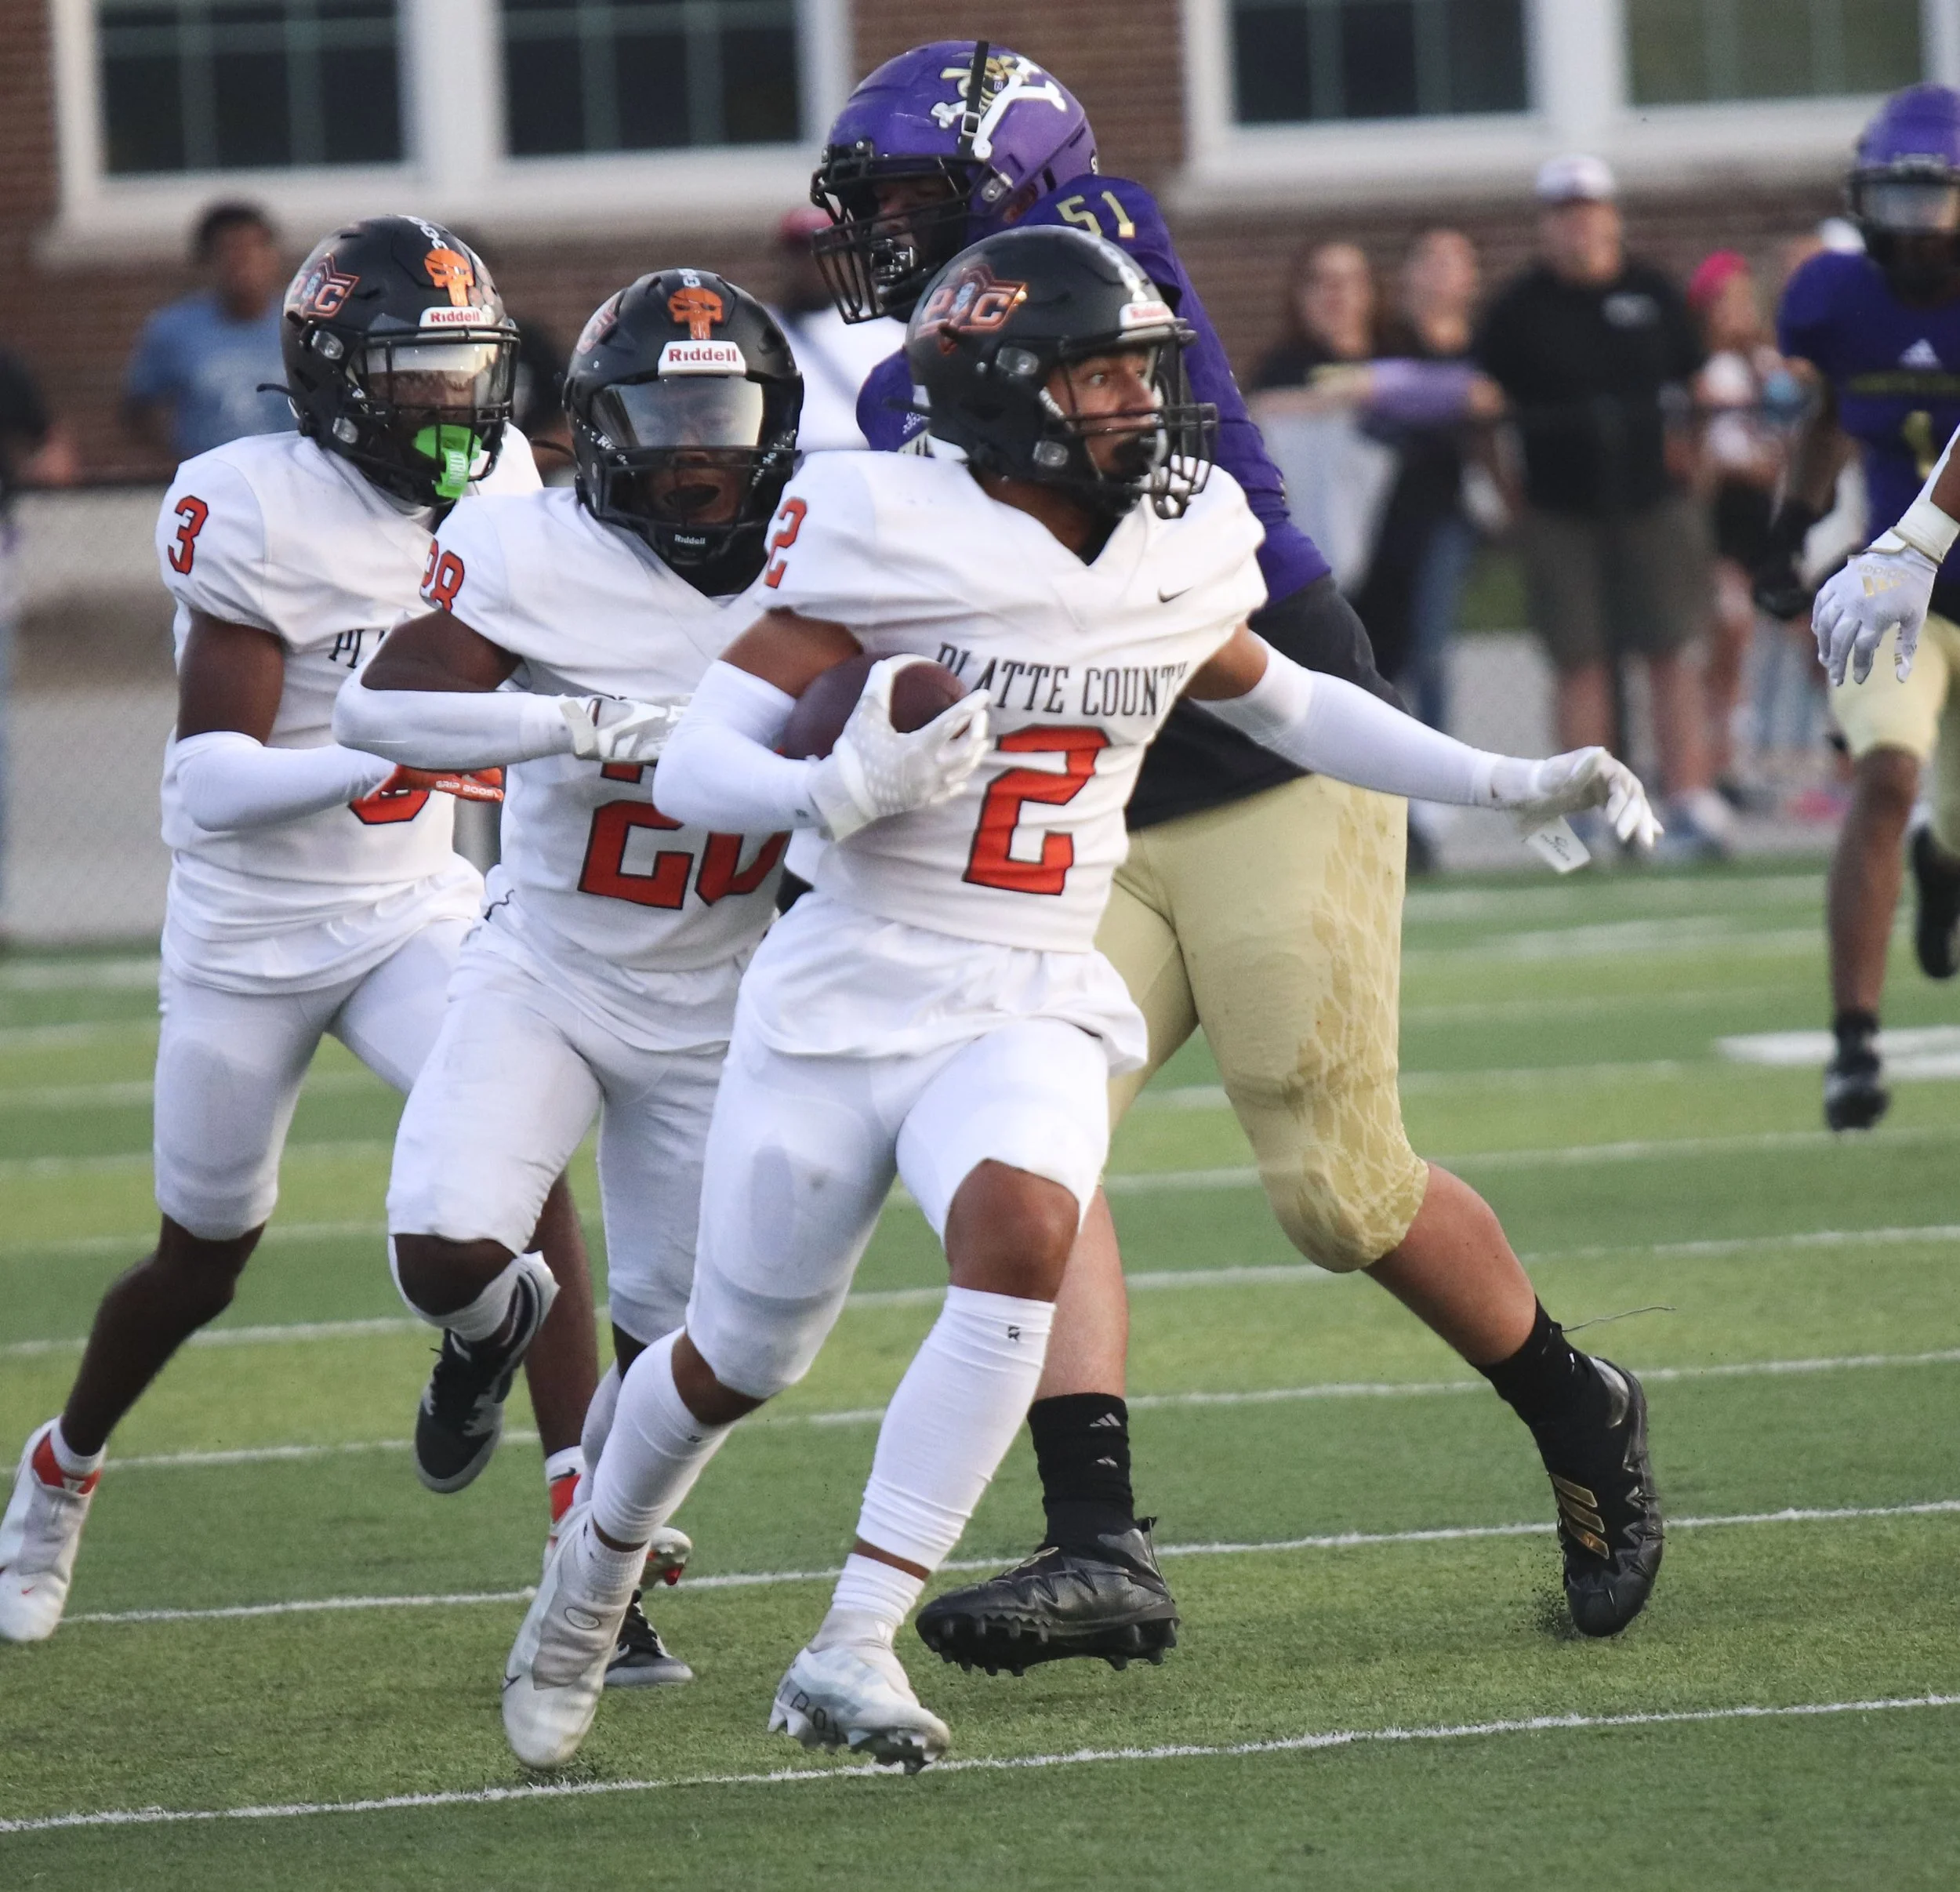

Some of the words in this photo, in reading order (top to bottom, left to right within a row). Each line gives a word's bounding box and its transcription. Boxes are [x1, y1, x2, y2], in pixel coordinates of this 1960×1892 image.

[1055, 191, 1135, 238] 51
[430, 310, 481, 324] Riddell
[668, 347, 738, 363] Riddell
[167, 495, 209, 576] 3
[673, 533, 706, 547] Riddell
[764, 496, 808, 590] 2
[435, 780, 460, 790] GRIP
[961, 723, 1112, 896] 2
